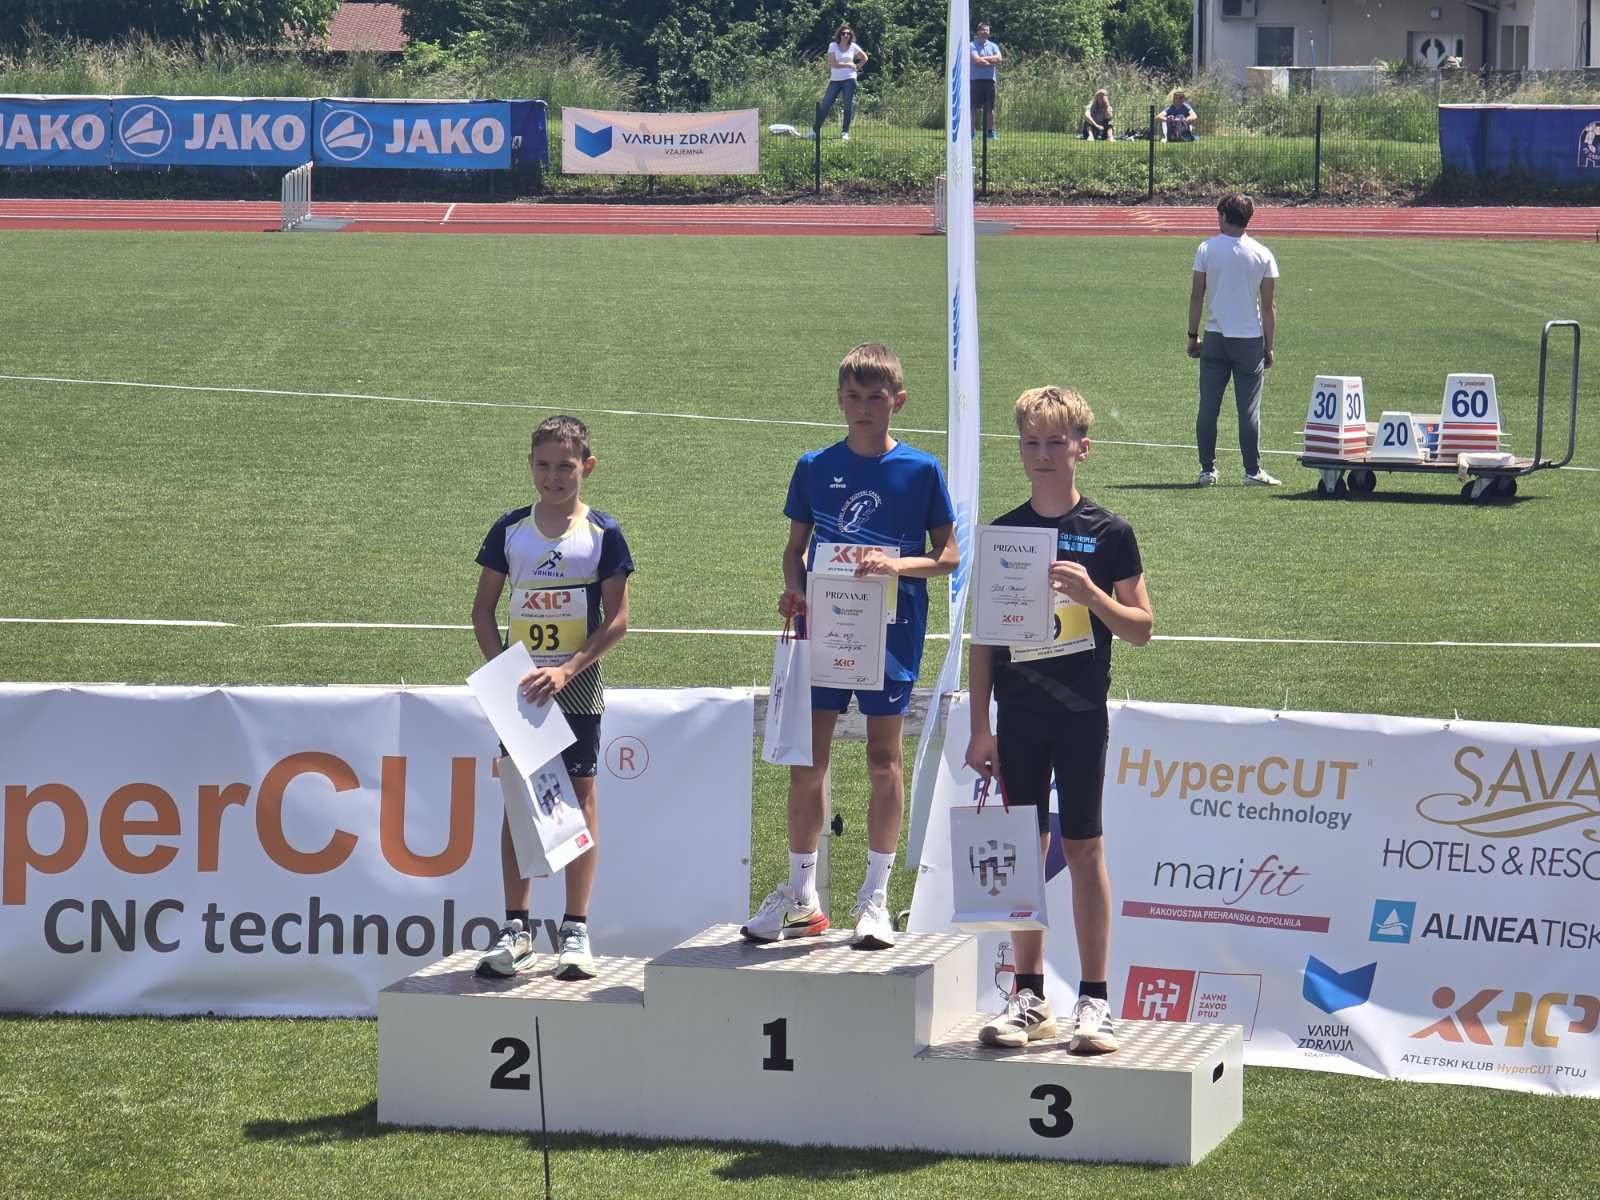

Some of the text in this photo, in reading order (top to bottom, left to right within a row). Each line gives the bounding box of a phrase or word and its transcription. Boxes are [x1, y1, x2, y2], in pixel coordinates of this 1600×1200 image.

[0, 112, 105, 150] AKO
[184, 113, 305, 152] JAKO
[384, 117, 505, 154] JAKO
[622, 132, 746, 145] VARUH ZDRAVJA
[1313, 391, 1337, 420] 30
[1345, 392, 1361, 421] 30
[1451, 390, 1489, 418] 60
[1383, 422, 1409, 447] 20
[992, 543, 1038, 554] PRIZNANJE
[825, 591, 871, 602] PRIZNANJE
[529, 623, 560, 651] 93
[1116, 746, 1359, 800] HyperCUT
[1189, 797, 1352, 830] CNC technology
[3, 751, 502, 906] perCU
[1383, 838, 1496, 874] HOTELS
[1502, 845, 1523, 875] &
[44, 898, 185, 956] CNC
[1150, 907, 1302, 928] KAKOVOSTNA PREHRANSKA DOPOLNILA
[1198, 1002, 1227, 1011] ZAVOD
[1200, 993, 1227, 1002] JAVNI
[1197, 1010, 1219, 1019] PTUJ
[762, 1017, 795, 1071] 1
[1297, 1038, 1355, 1052] ZDRAVJA
[1307, 1024, 1350, 1038] VARUH
[490, 1036, 531, 1091] 2
[1400, 1054, 1587, 1078] ATLETSKI KLUB HyperCUT PTUJ
[1029, 1083, 1074, 1138] 3
